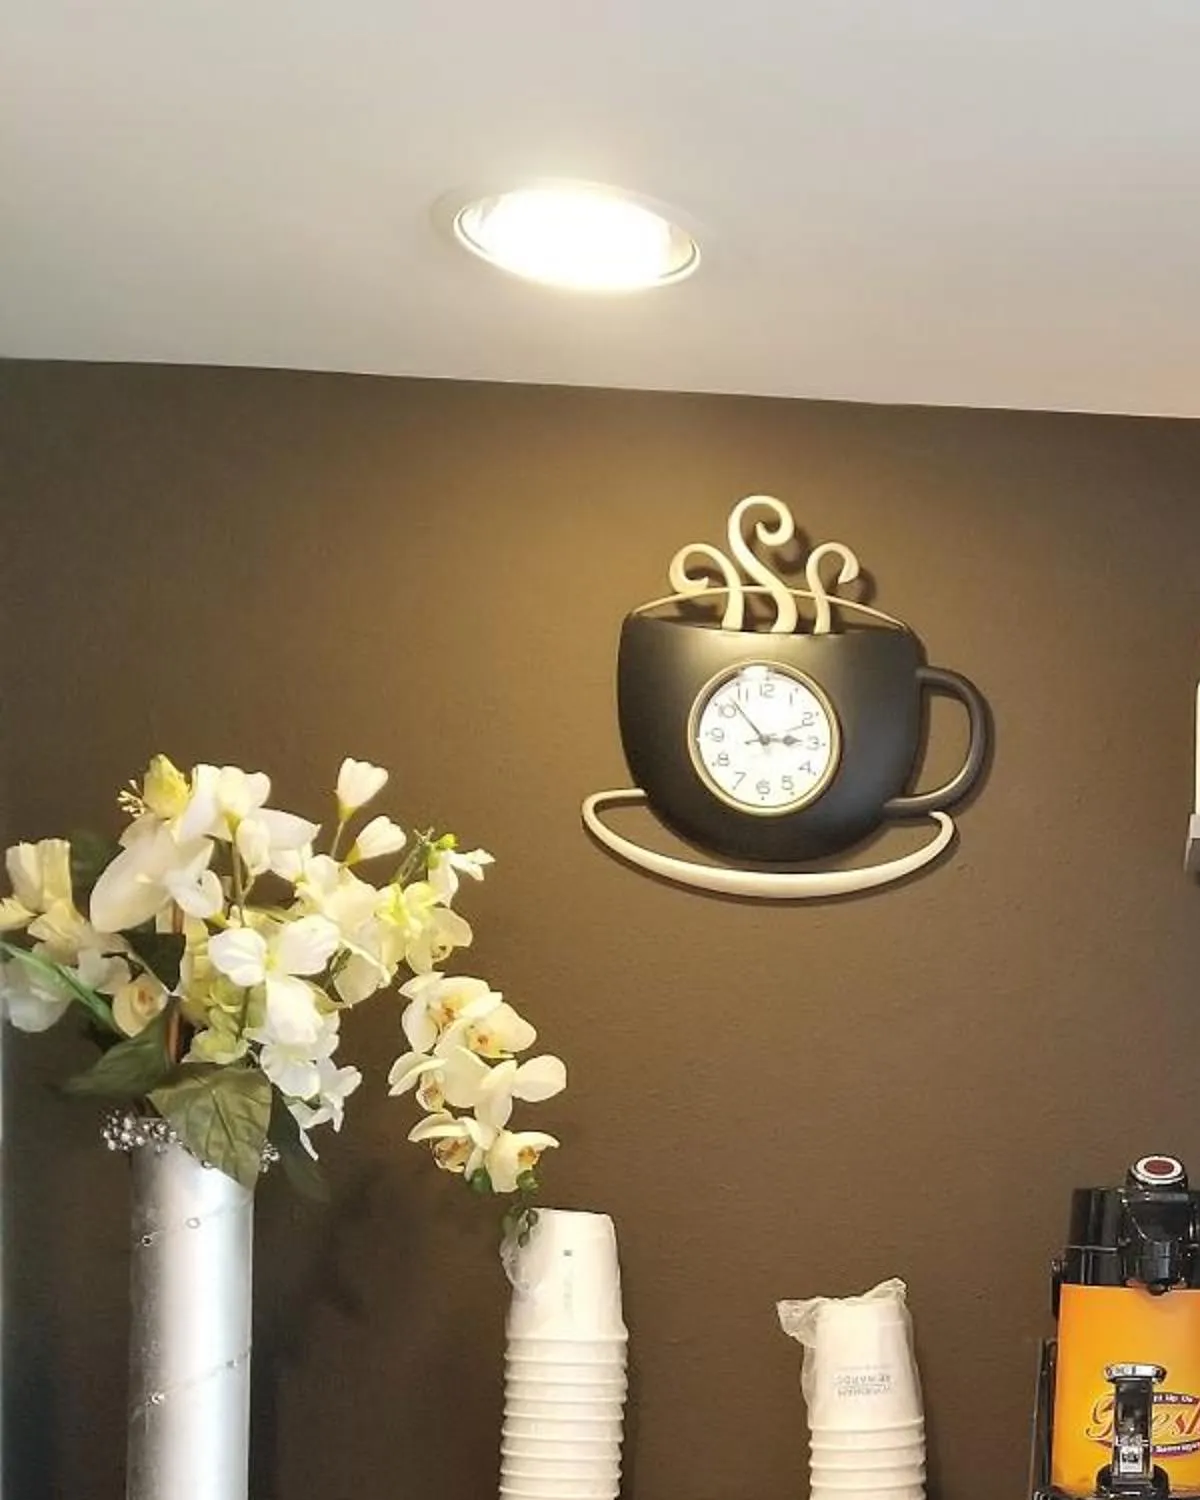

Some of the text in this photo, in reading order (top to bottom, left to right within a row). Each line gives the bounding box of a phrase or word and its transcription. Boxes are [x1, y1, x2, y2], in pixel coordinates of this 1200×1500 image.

[759, 683, 776, 698] 12
[801, 711, 815, 727] 2
[710, 727, 725, 743] 9
[807, 735, 820, 751] 3
[717, 751, 731, 767] 8
[799, 760, 812, 773] 4
[732, 771, 747, 790] 7
[756, 779, 771, 795] 6
[781, 775, 794, 791] 5
